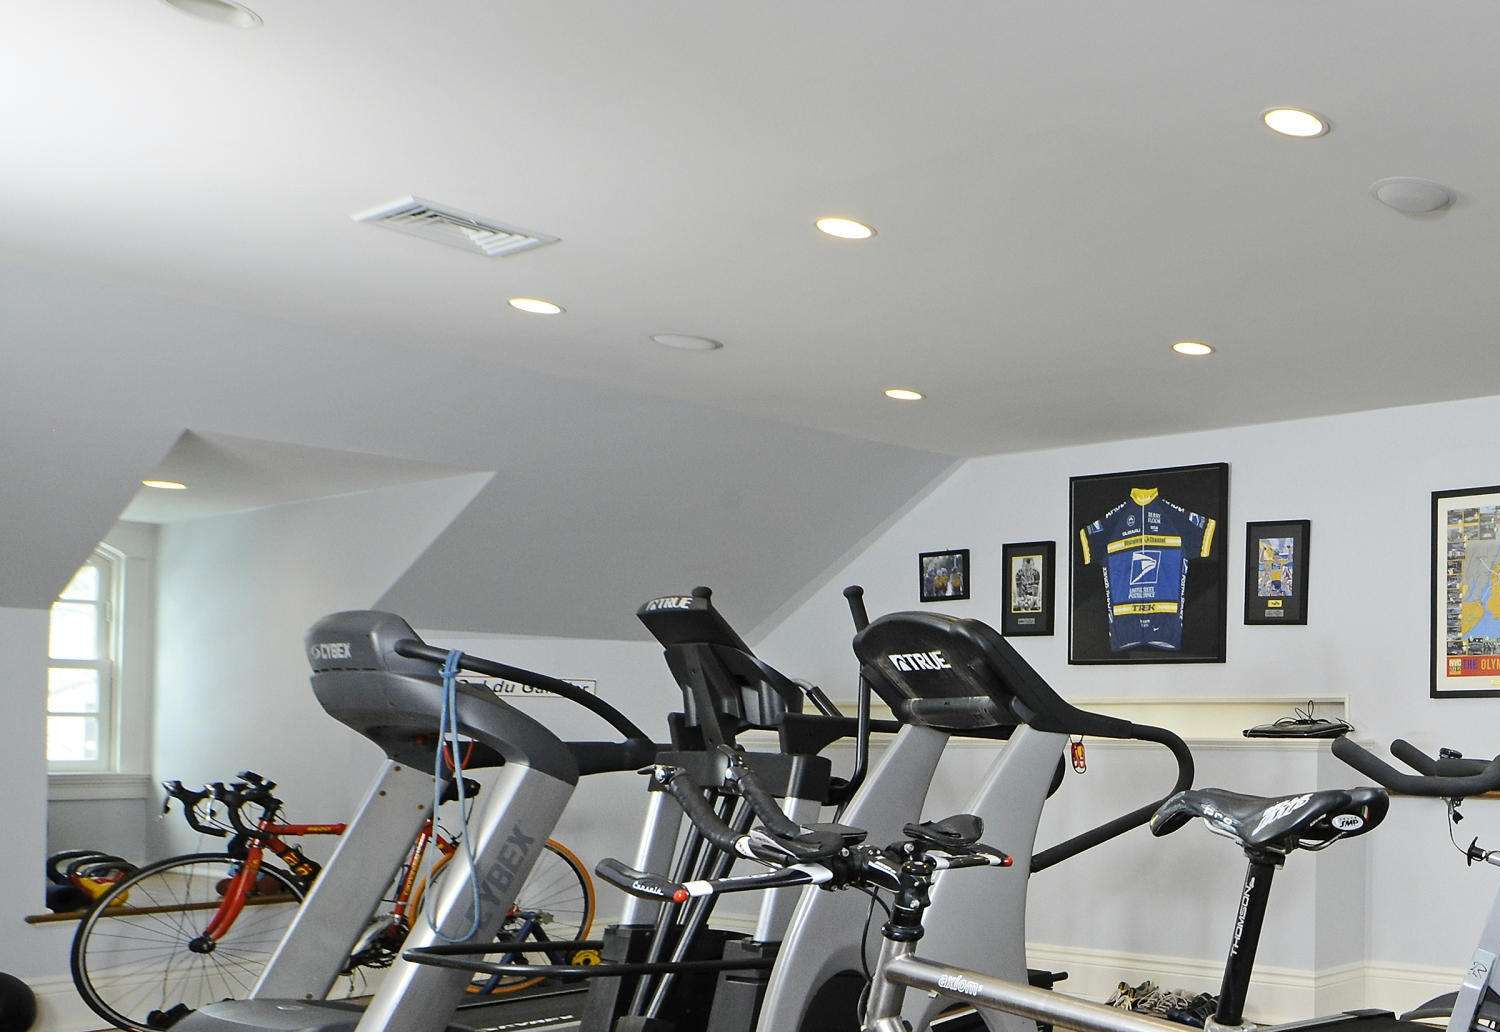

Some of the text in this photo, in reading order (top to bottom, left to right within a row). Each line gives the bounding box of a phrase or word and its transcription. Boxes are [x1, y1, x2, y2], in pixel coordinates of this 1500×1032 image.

[1131, 603, 1156, 612] TREK
[319, 642, 352, 660] CYBEX
[903, 649, 953, 671] TRUE
[1462, 659, 1478, 671] THE
[492, 680, 515, 693] du
[1231, 883, 1255, 957] THOMSON
